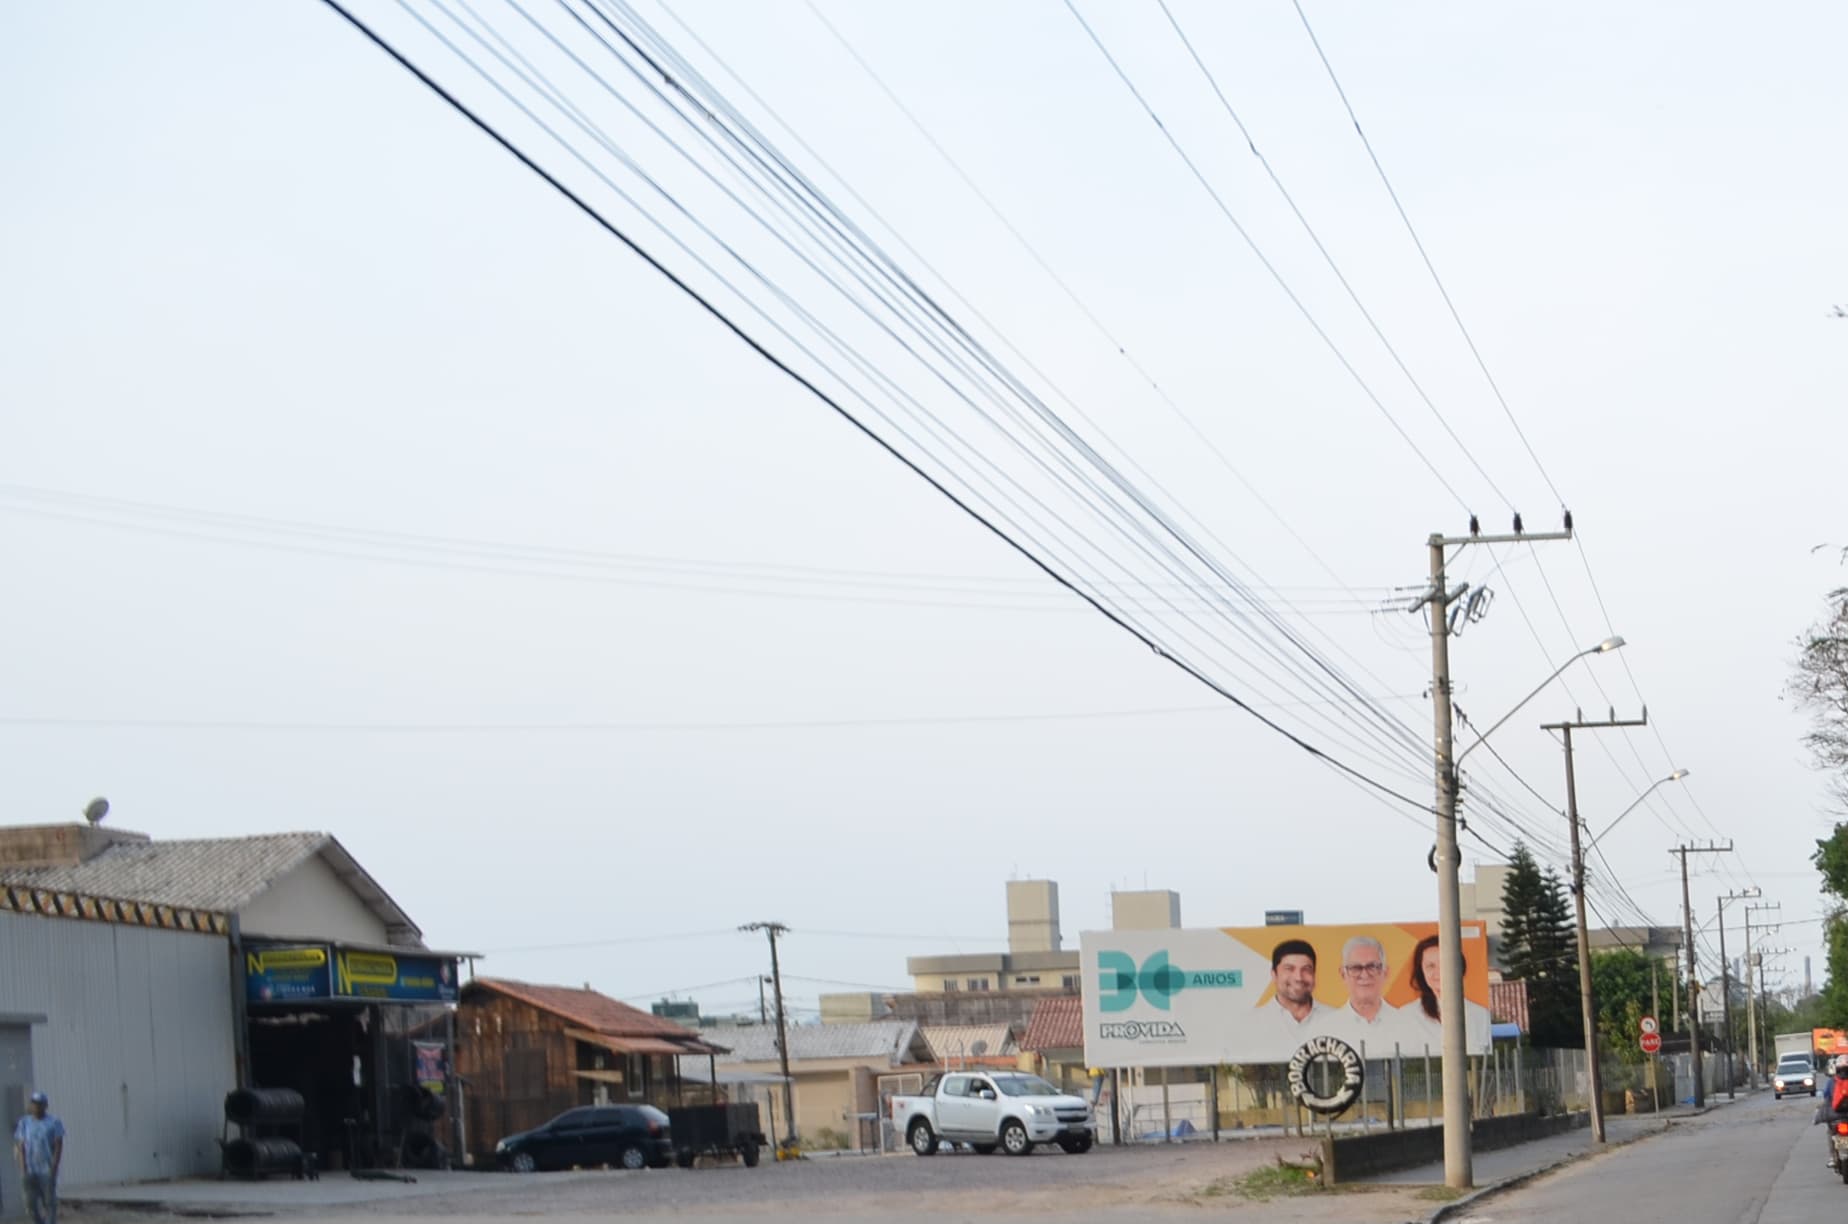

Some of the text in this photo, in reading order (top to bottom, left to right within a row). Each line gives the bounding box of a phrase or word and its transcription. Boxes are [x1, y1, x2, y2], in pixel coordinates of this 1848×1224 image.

[1192, 972, 1237, 986] ANOS
[1099, 1020, 1186, 1040] PROVIDA
[1288, 1036, 1361, 1097] BORRACHARIA
